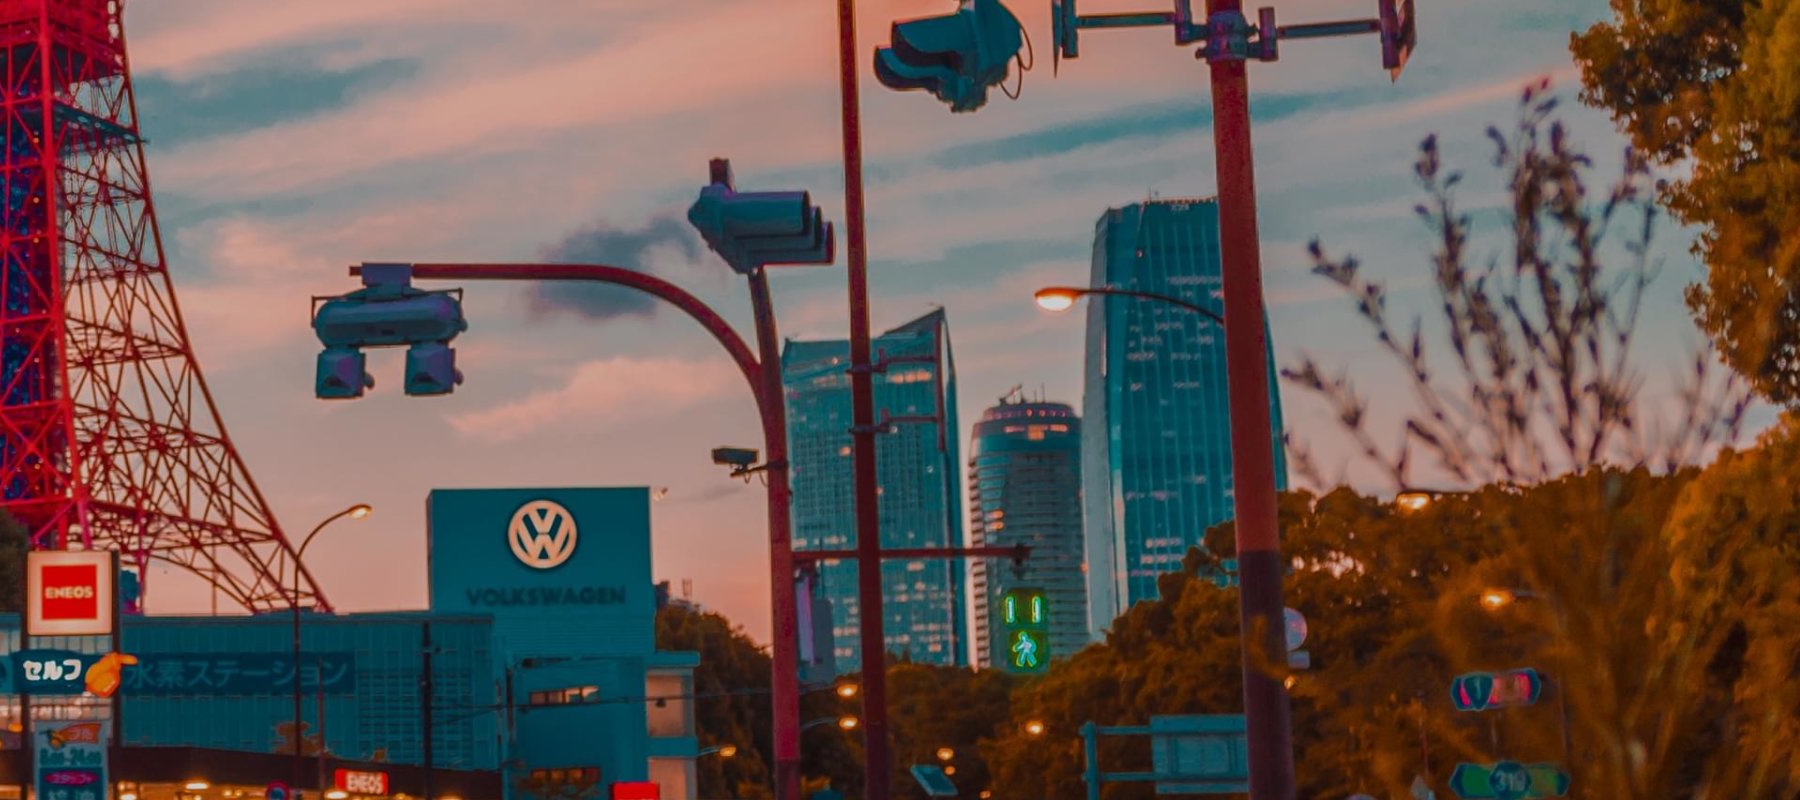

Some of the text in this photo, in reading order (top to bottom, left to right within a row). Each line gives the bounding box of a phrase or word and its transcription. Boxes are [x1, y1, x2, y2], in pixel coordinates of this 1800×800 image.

[45, 585, 94, 599] ENEOS
[465, 585, 627, 607] VOLKSWAGEN
[23, 659, 81, 681] セルフ
[126, 660, 348, 688] 水素ステーション
[347, 771, 383, 794] ENEOS
